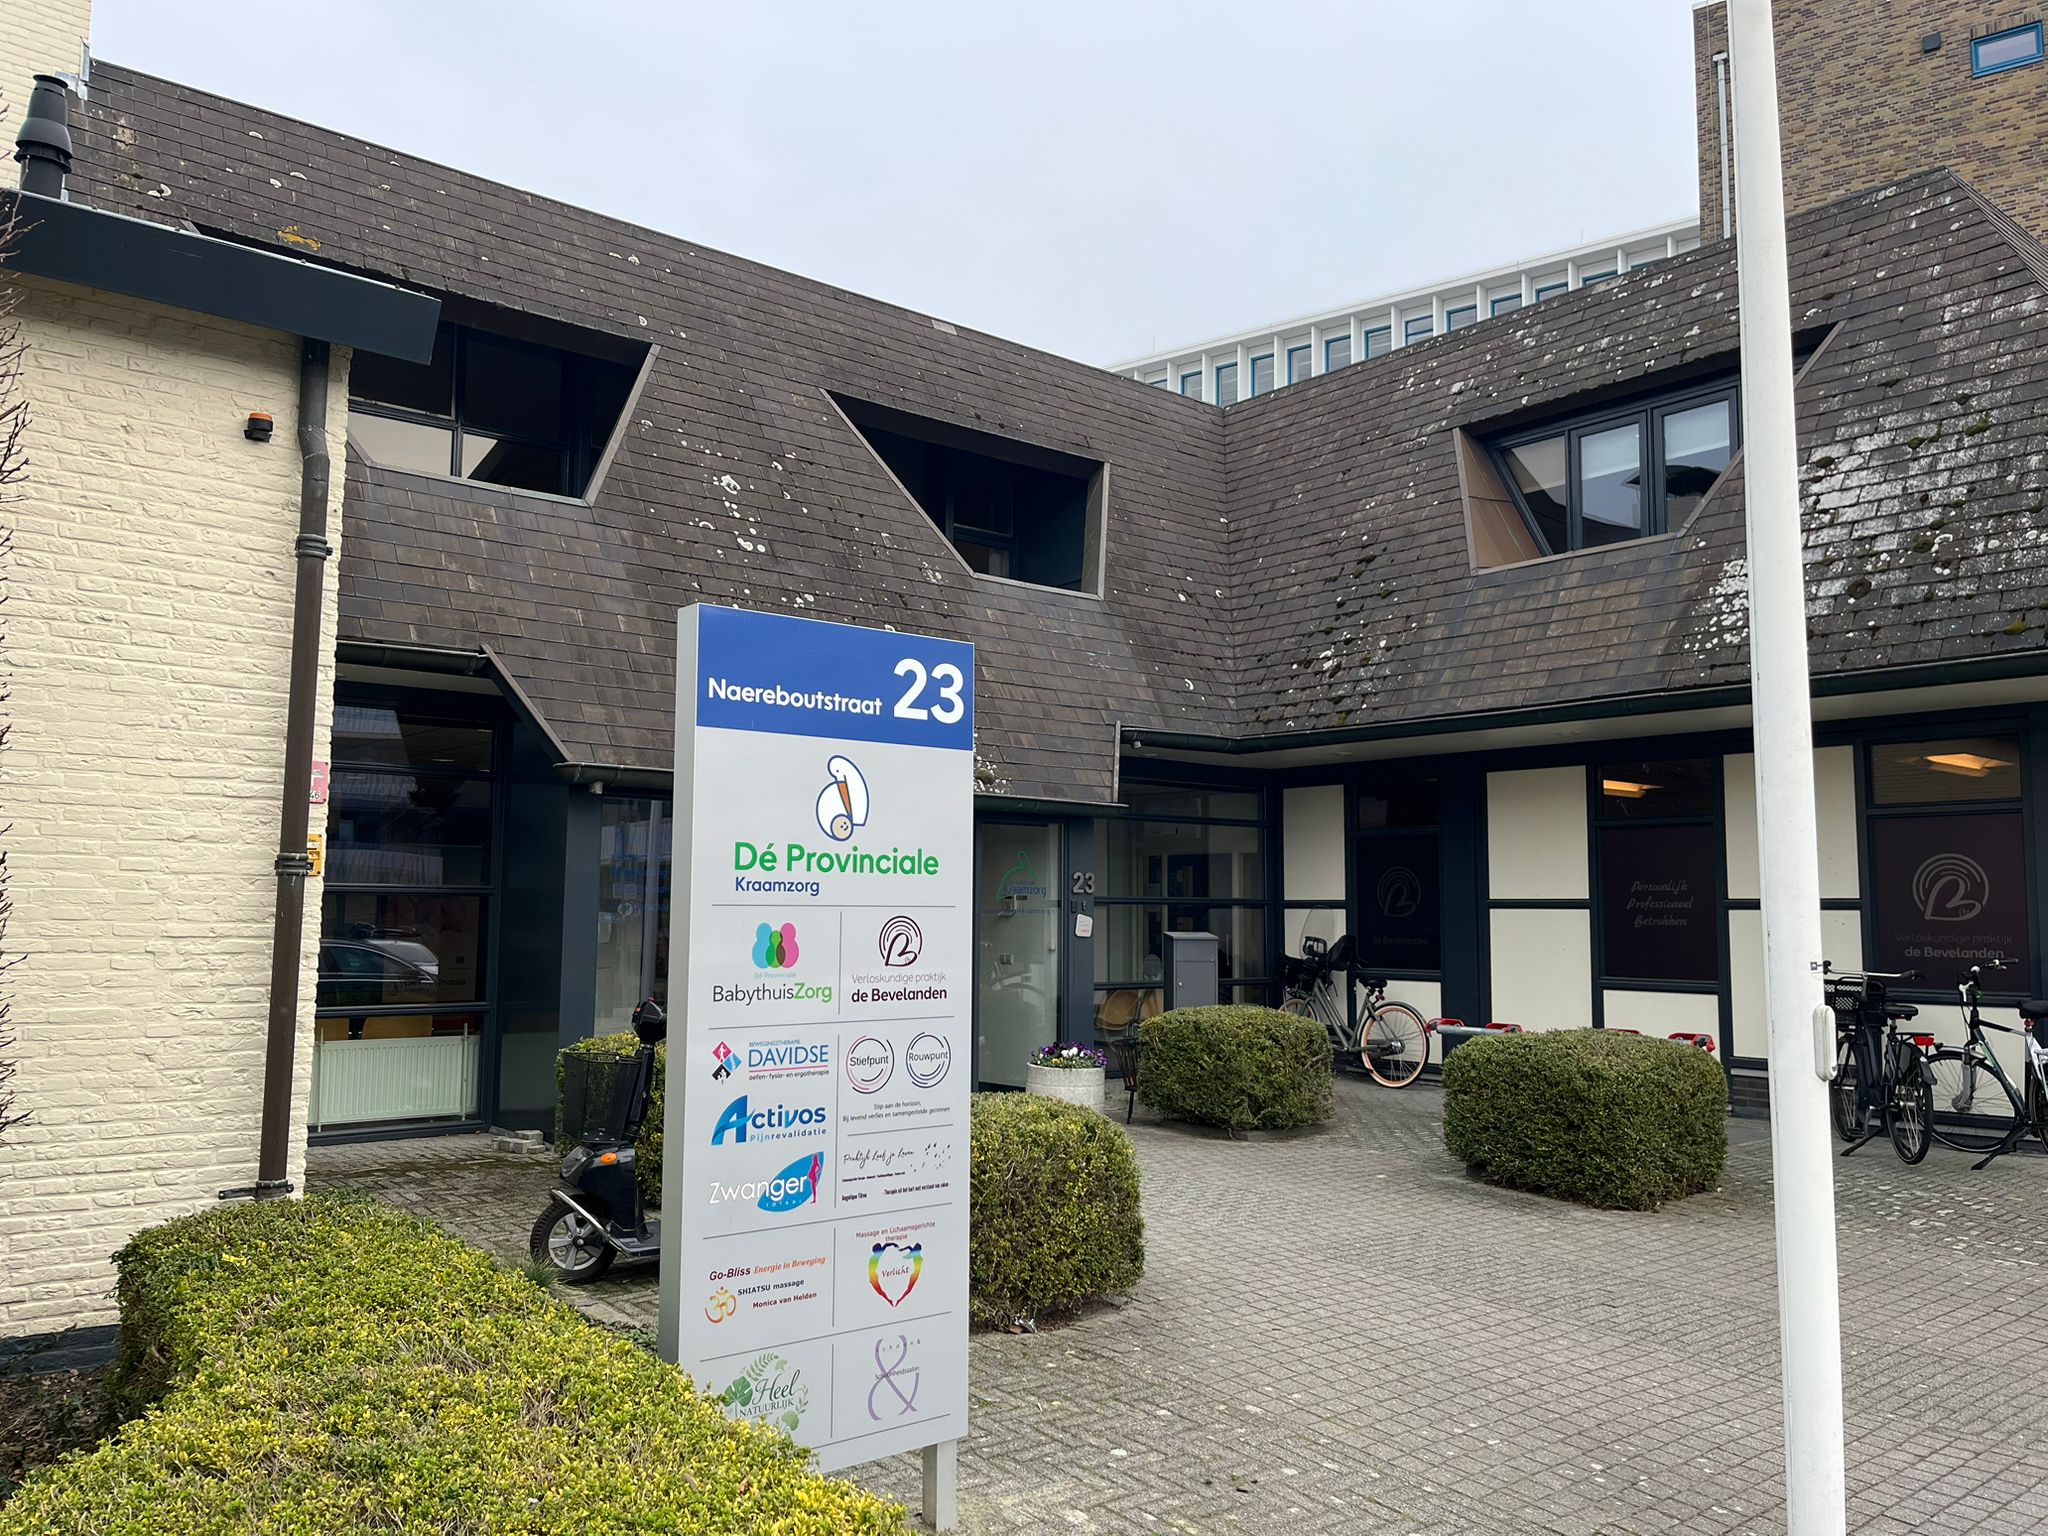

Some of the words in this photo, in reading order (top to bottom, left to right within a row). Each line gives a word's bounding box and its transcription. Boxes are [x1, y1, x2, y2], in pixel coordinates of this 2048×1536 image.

[708, 677, 882, 716] Naereboutstraat
[893, 658, 965, 724] 23
[734, 842, 777, 872] Dé
[787, 843, 939, 875] Provinciale
[735, 877, 820, 897] Kraamzorg
[1072, 872, 1096, 893] 23
[1904, 946, 1920, 957] de
[1924, 946, 2005, 959] Bevelanden
[852, 973, 914, 985] Verloskundige
[915, 972, 947, 983] praktijk
[713, 982, 833, 1006] BabythuisZorg
[851, 989, 868, 1002] de
[872, 987, 947, 1002] Bevelanden
[748, 1045, 829, 1067] DAVIDSE
[850, 1055, 889, 1067] Stiefpunt
[909, 1051, 949, 1062] Rouwpunt
[711, 1095, 827, 1145] Activos
[709, 1175, 807, 1204] Zwanger
[856, 1231, 880, 1239] Massage
[885, 1233, 908, 1242] therapie
[709, 1267, 751, 1281] Go-Bliss
[754, 1263, 781, 1274] Energie
[791, 1256, 826, 1268] Beweging
[882, 1265, 909, 1277] Verlicht
[737, 1284, 771, 1296] SHIATSU
[773, 1279, 805, 1290] massage
[752, 1299, 777, 1309] Monica
[752, 1369, 801, 1405] Heel
[740, 1398, 794, 1418] NATUURLIJK
